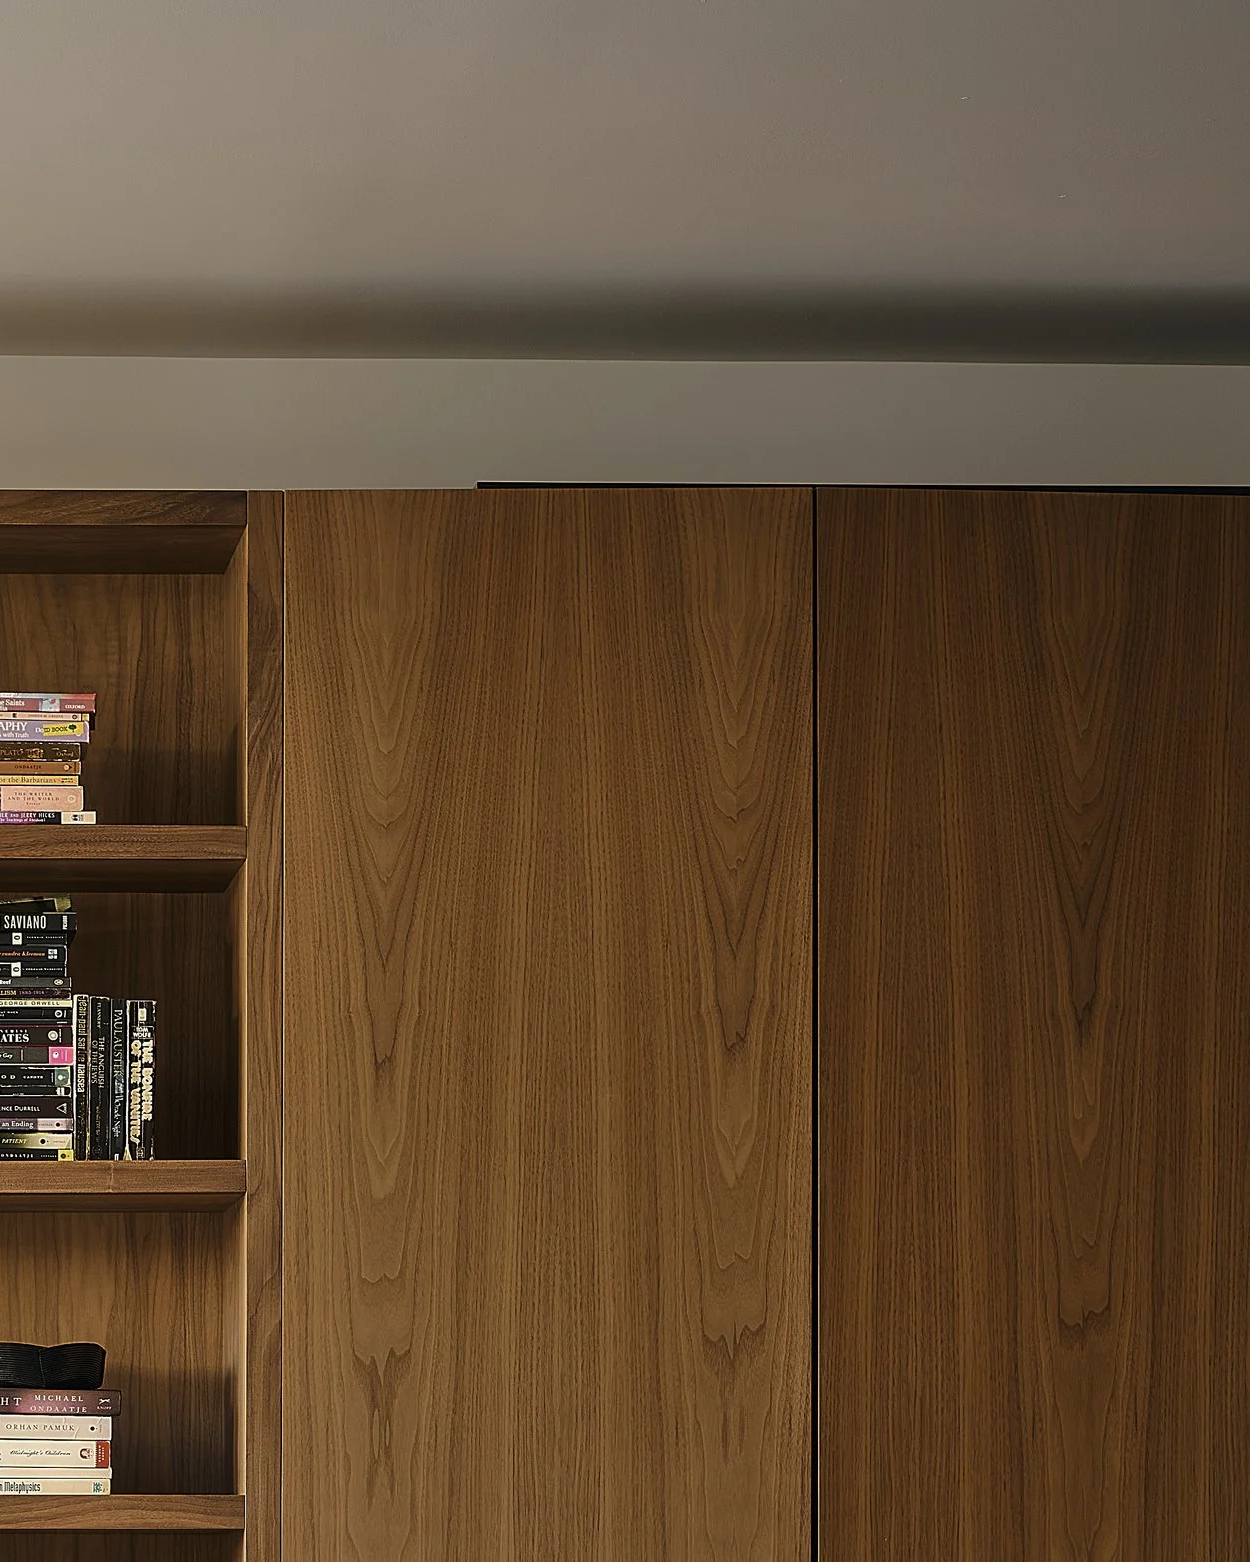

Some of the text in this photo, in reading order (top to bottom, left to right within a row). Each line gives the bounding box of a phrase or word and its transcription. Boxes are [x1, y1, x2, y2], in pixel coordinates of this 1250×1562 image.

[4, 915, 46, 929] SAVIANO
[35, 1394, 83, 1402] MICHAEL
[4, 1482, 40, 1493] Metaphysics
